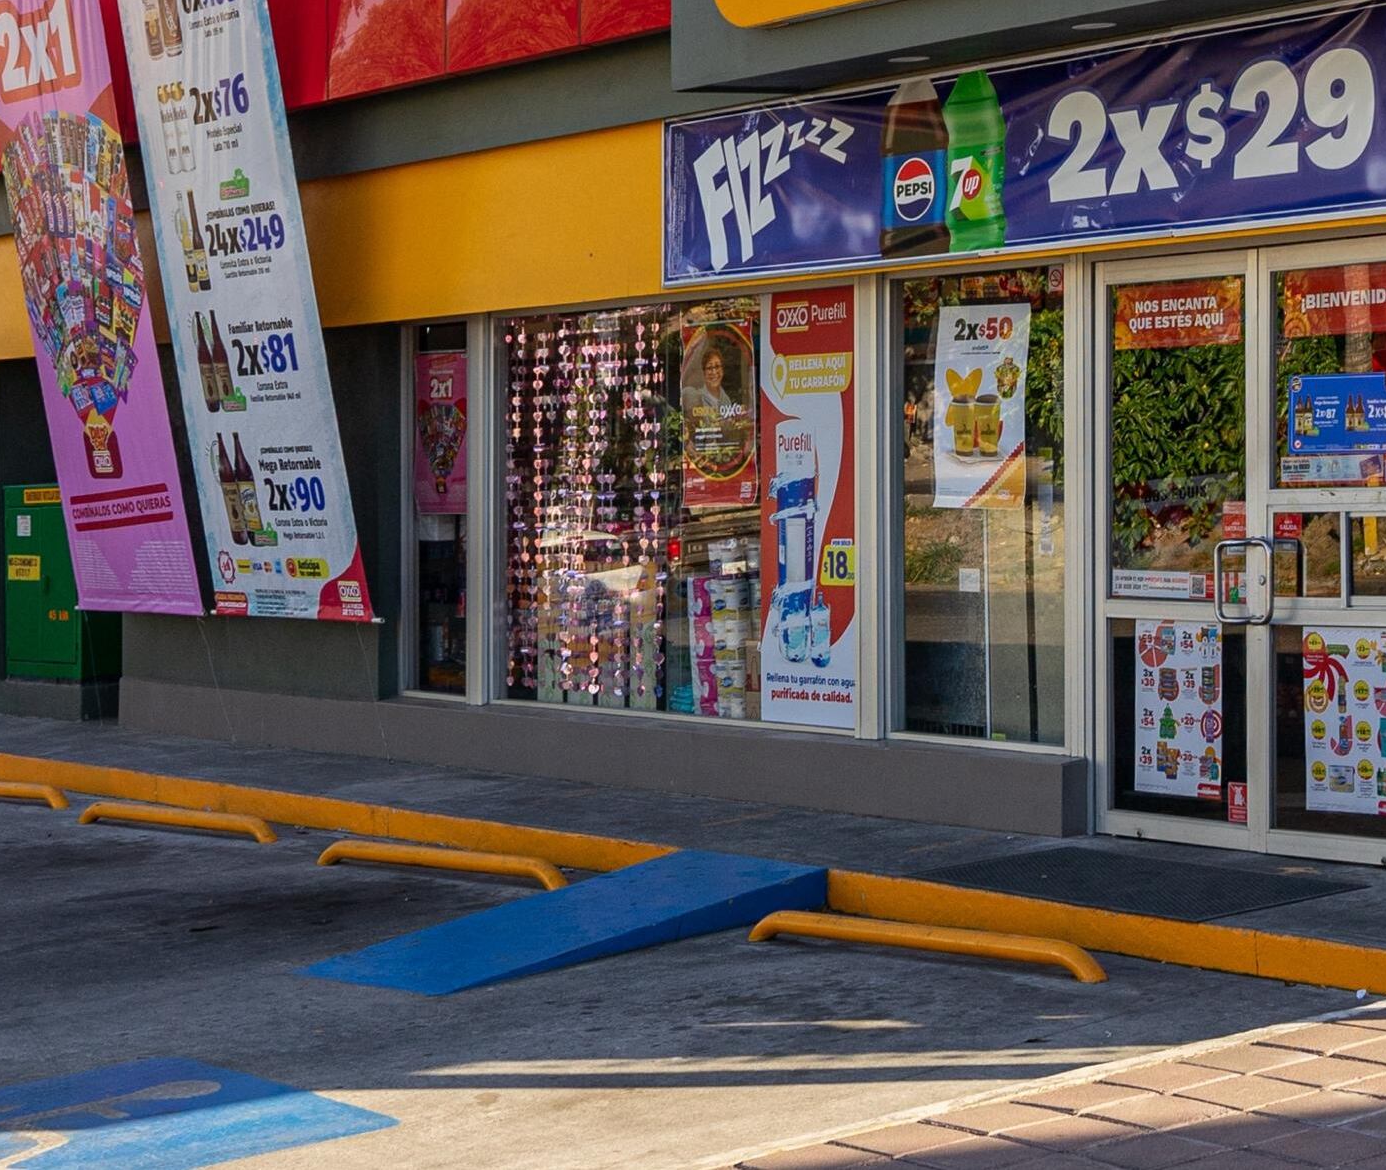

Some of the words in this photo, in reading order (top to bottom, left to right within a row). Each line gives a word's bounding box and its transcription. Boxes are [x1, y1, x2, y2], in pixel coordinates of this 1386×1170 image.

[896, 181, 933, 197] PEPSI
[1135, 300, 1159, 314] NOS
[1161, 296, 1218, 313] ENCANTA
[777, 305, 808, 328] OXXO
[811, 301, 847, 321] Purefill
[1129, 316, 1152, 331] QUE
[1154, 311, 1192, 328] ESTÉS
[1194, 309, 1224, 328] AQUÍ
[255, 317, 293, 332] Retornable
[954, 316, 1013, 342] 2x$50
[789, 358, 823, 371] RELLENA
[826, 354, 846, 370] AQUÍ
[430, 378, 453, 399] 2x1
[789, 377, 800, 389] TU
[801, 371, 845, 389] GARRAFÓN
[720, 403, 742, 419] OXXO
[778, 432, 812, 452] Purefill
[258, 459, 278, 474] Mega
[278, 457, 322, 472] Retornable
[72, 506, 111, 520] COMBÍNALOS
[112, 501, 135, 516] COMO
[136, 495, 171, 513] QUIERAS
[767, 673, 789, 684] Rellena
[791, 674, 797, 684] tu
[828, 677, 839, 687] con
[771, 687, 809, 701] purificada
[811, 690, 820, 701] de
[822, 690, 853, 704] calidad.
